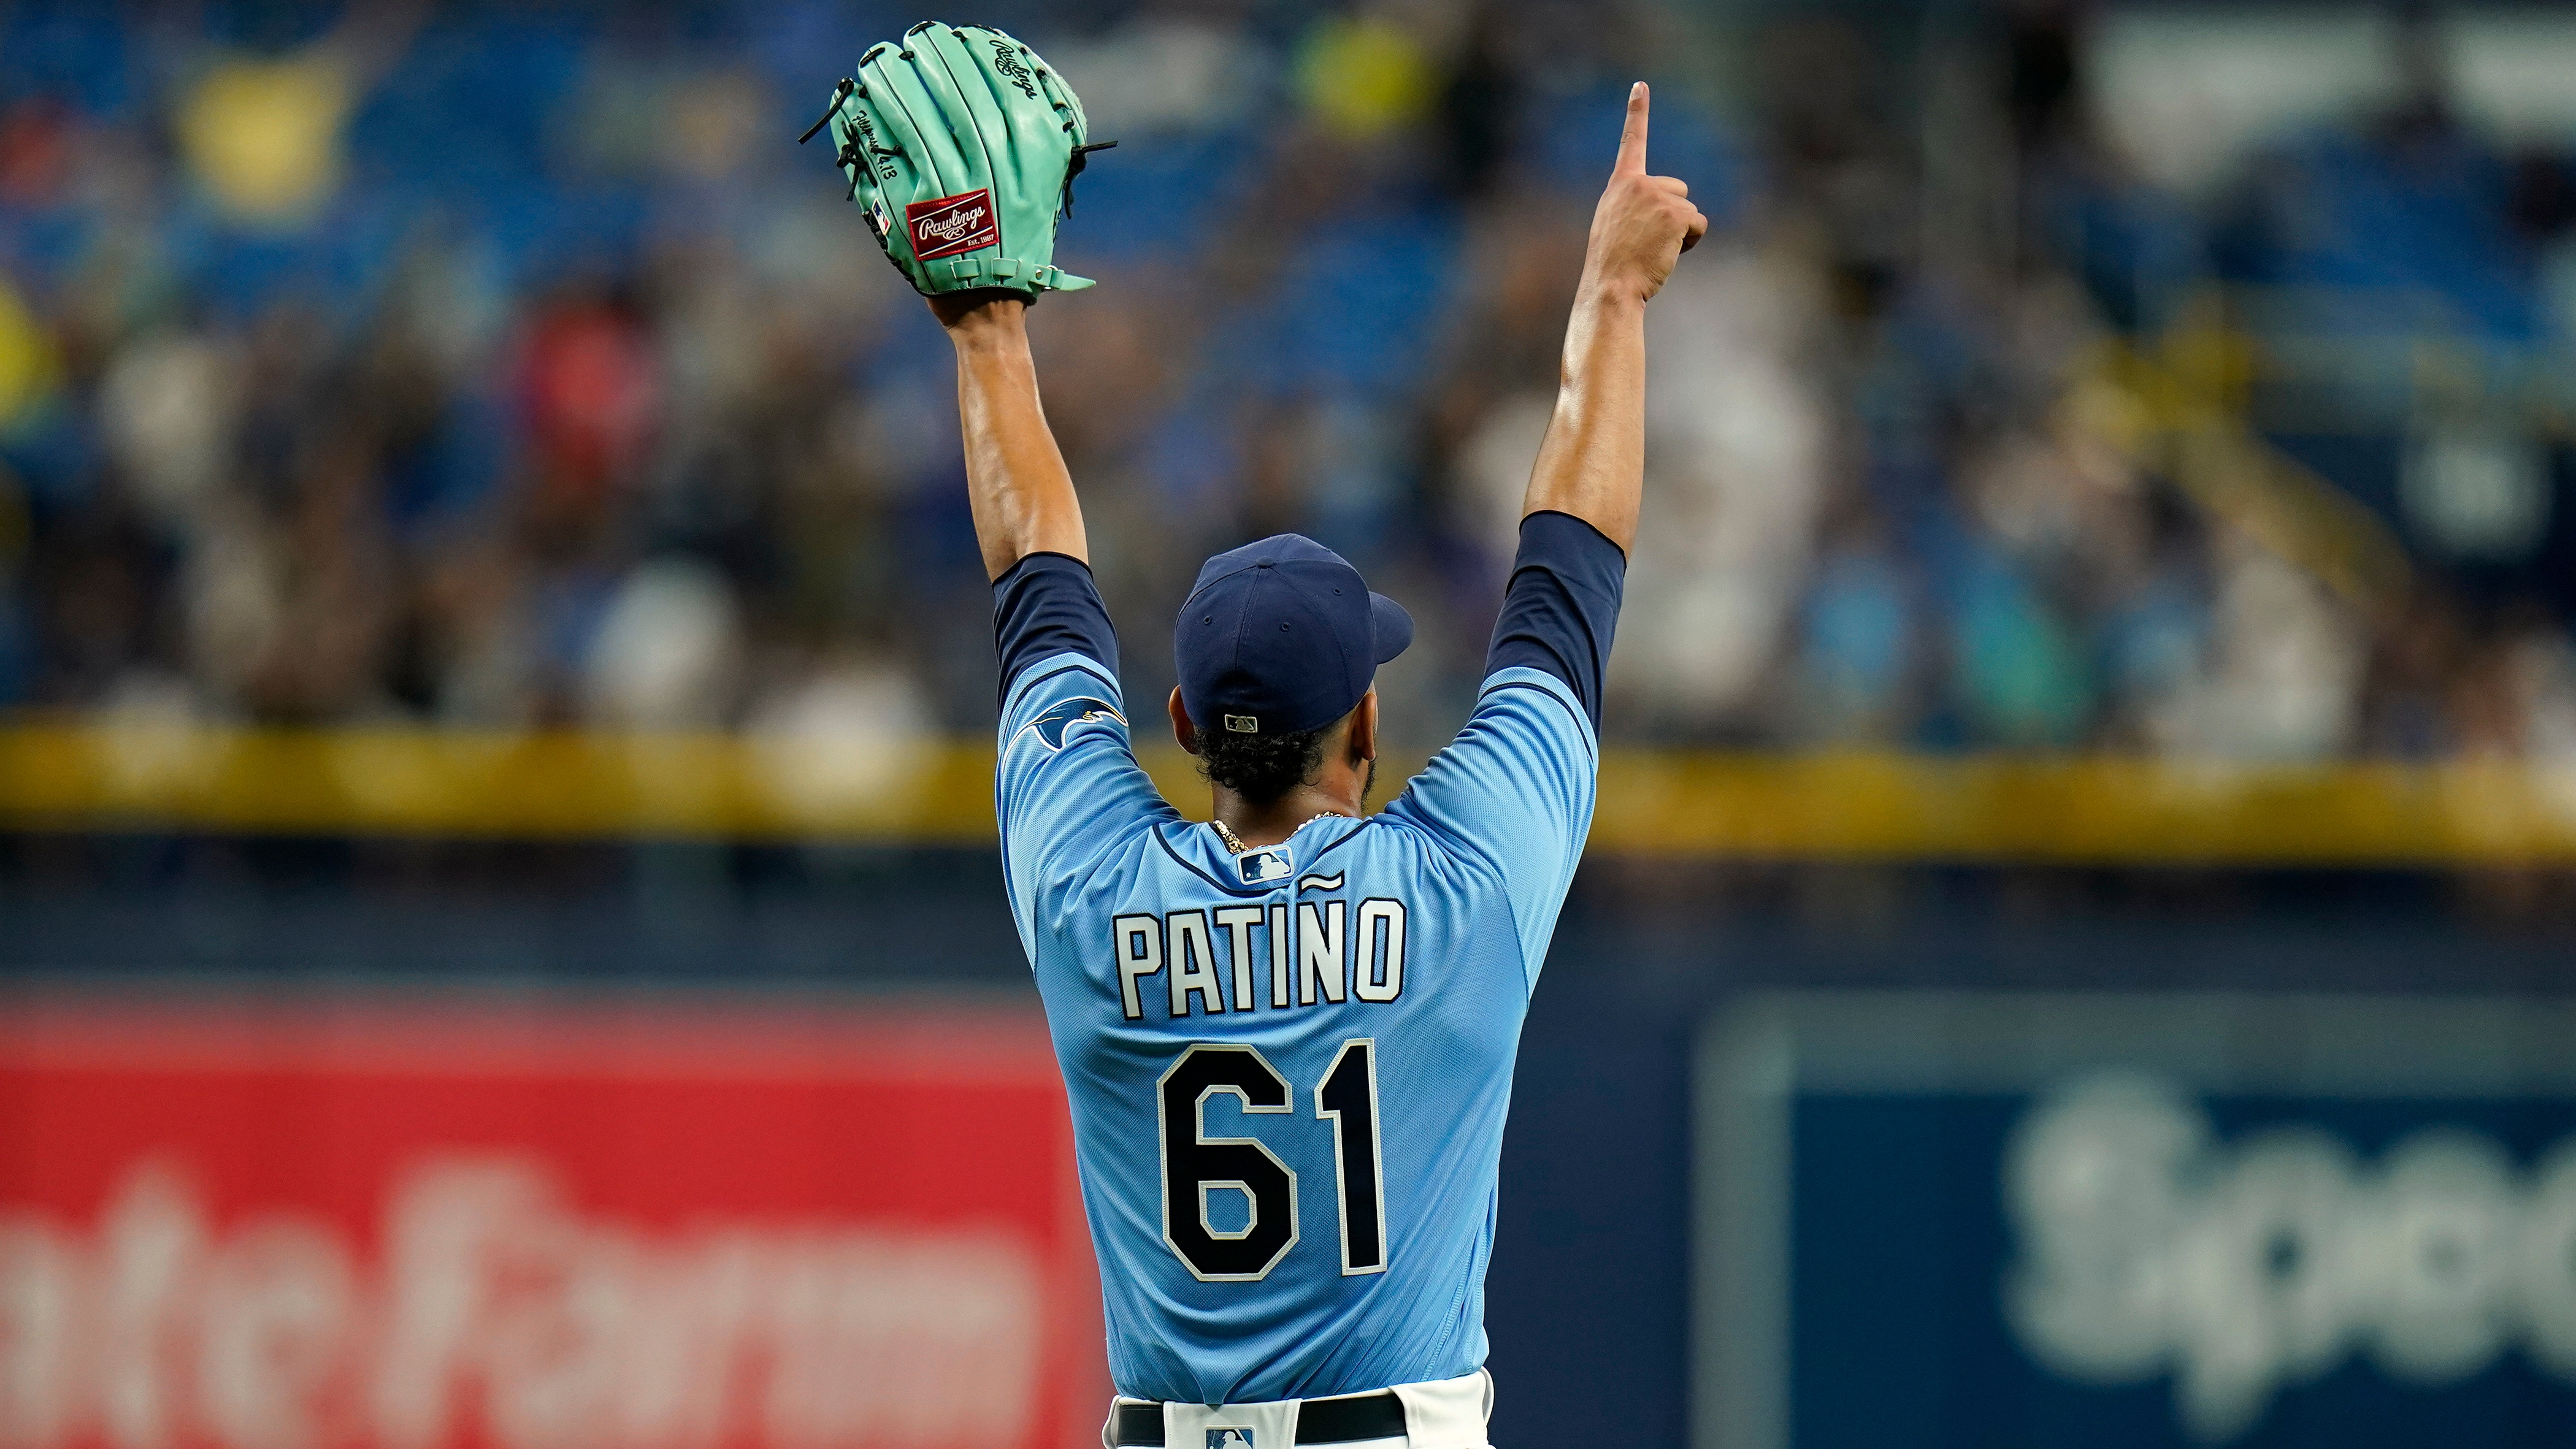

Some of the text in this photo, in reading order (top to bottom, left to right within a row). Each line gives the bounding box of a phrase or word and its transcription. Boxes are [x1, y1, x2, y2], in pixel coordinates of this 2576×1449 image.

[989, 40, 1038, 100] Rawlings
[918, 206, 986, 240] Rawlings
[980, 234, 994, 244] 1887
[1113, 870, 1406, 1021] PATIÑO
[1156, 1038, 1388, 1282] 61
